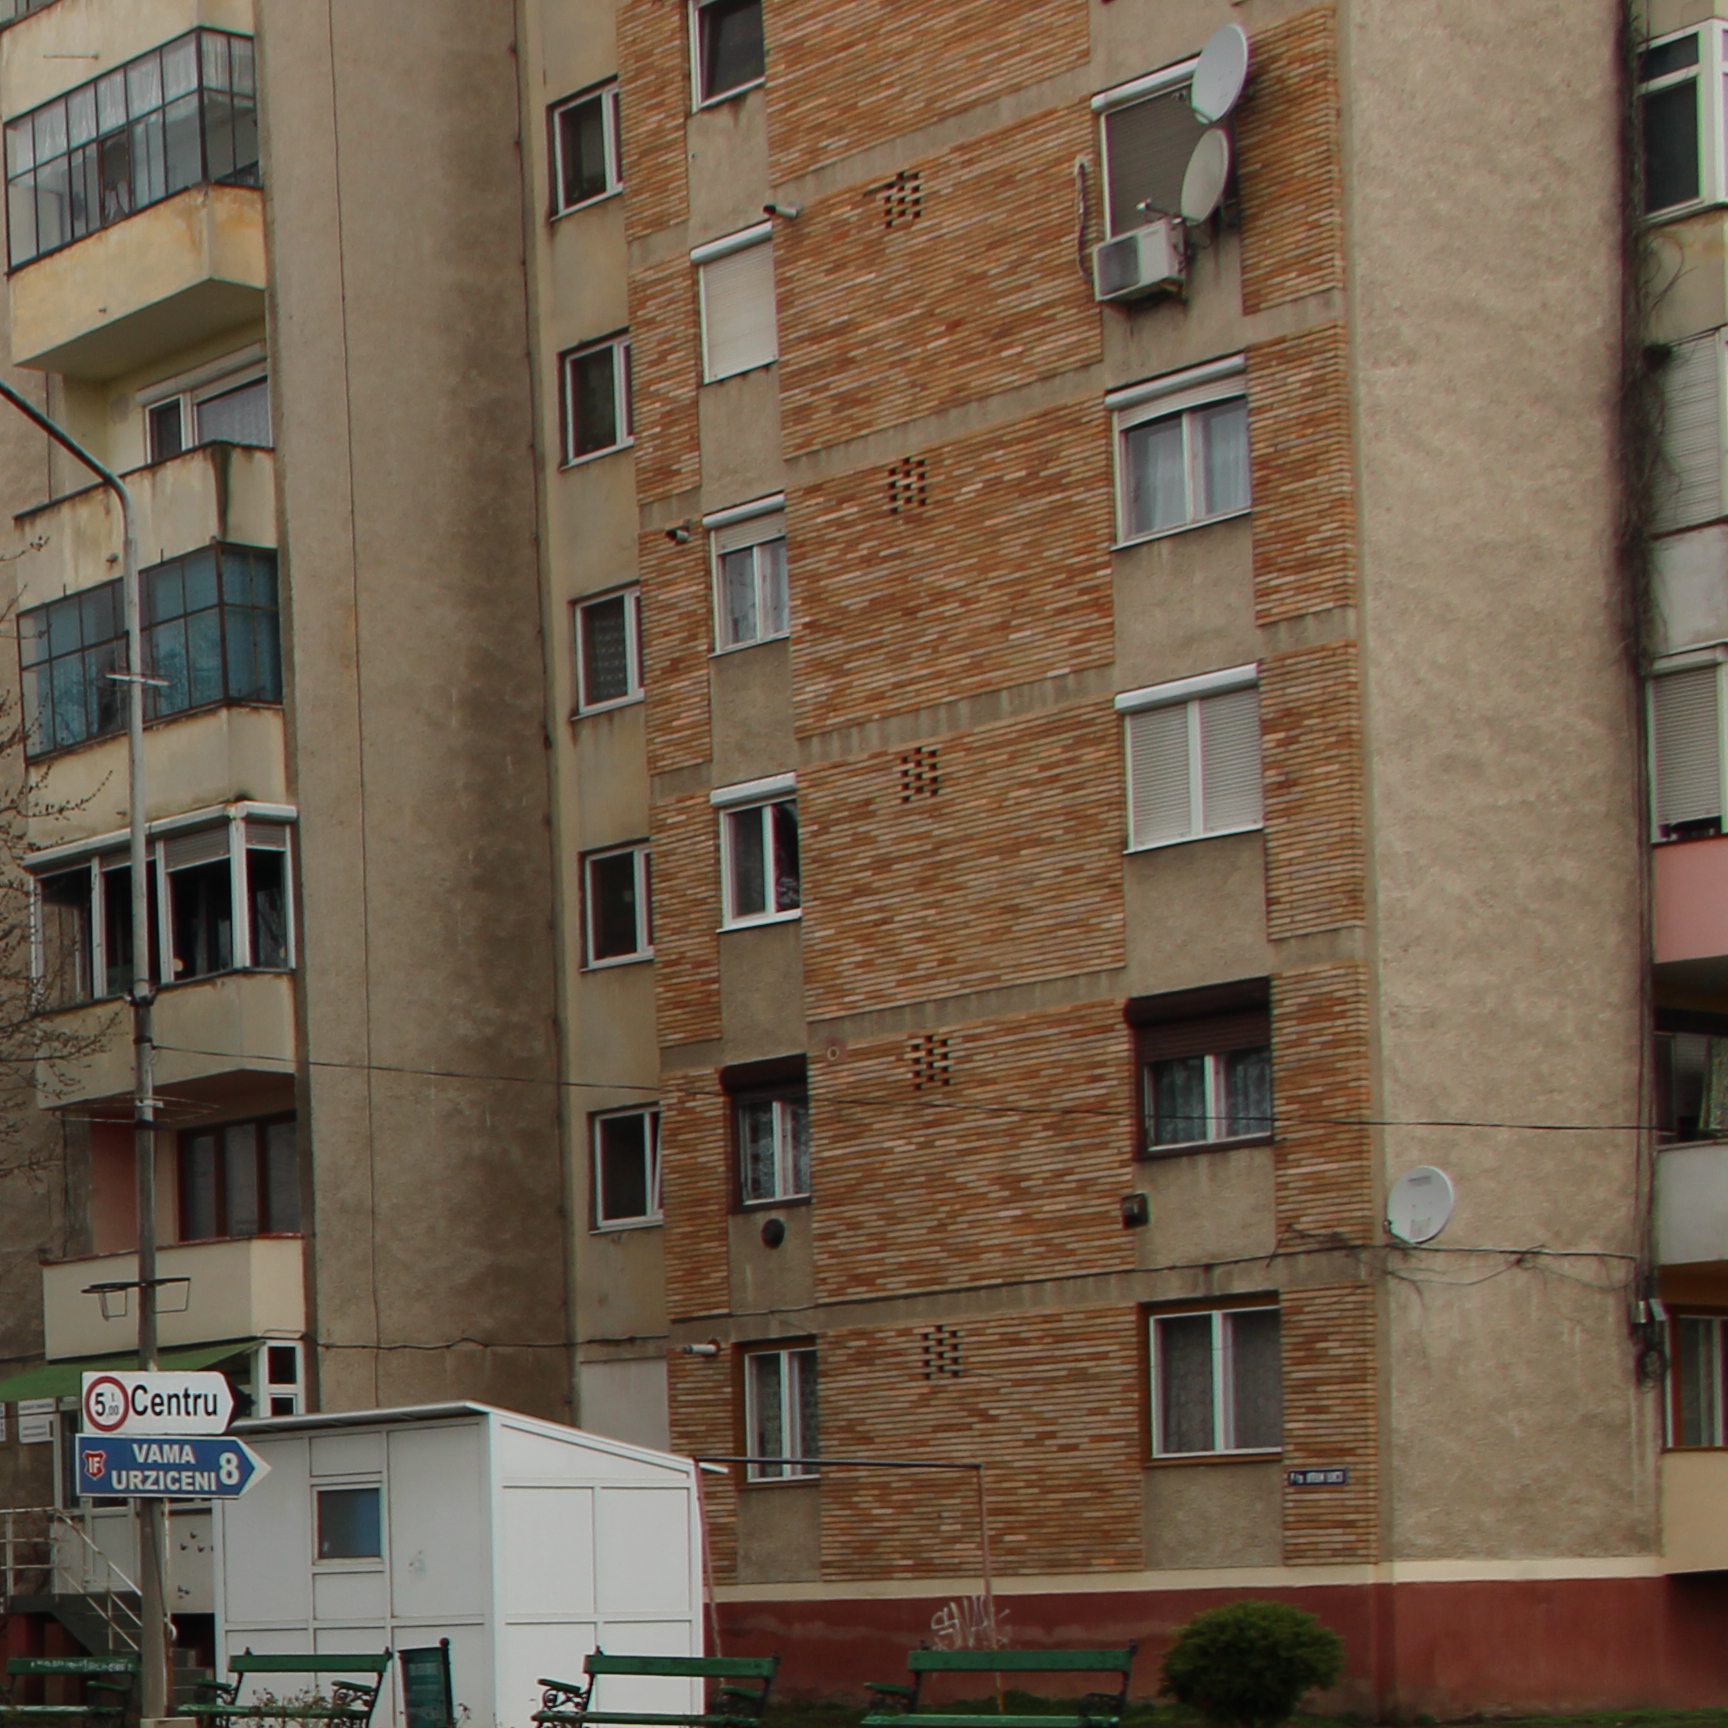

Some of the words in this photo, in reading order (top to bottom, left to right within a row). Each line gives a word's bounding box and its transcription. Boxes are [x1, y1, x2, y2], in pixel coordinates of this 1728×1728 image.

[131, 1384, 218, 1417] Centru
[132, 1443, 196, 1464] VAMA
[111, 1470, 217, 1491] URZICENI
[219, 1452, 240, 1485] 8
